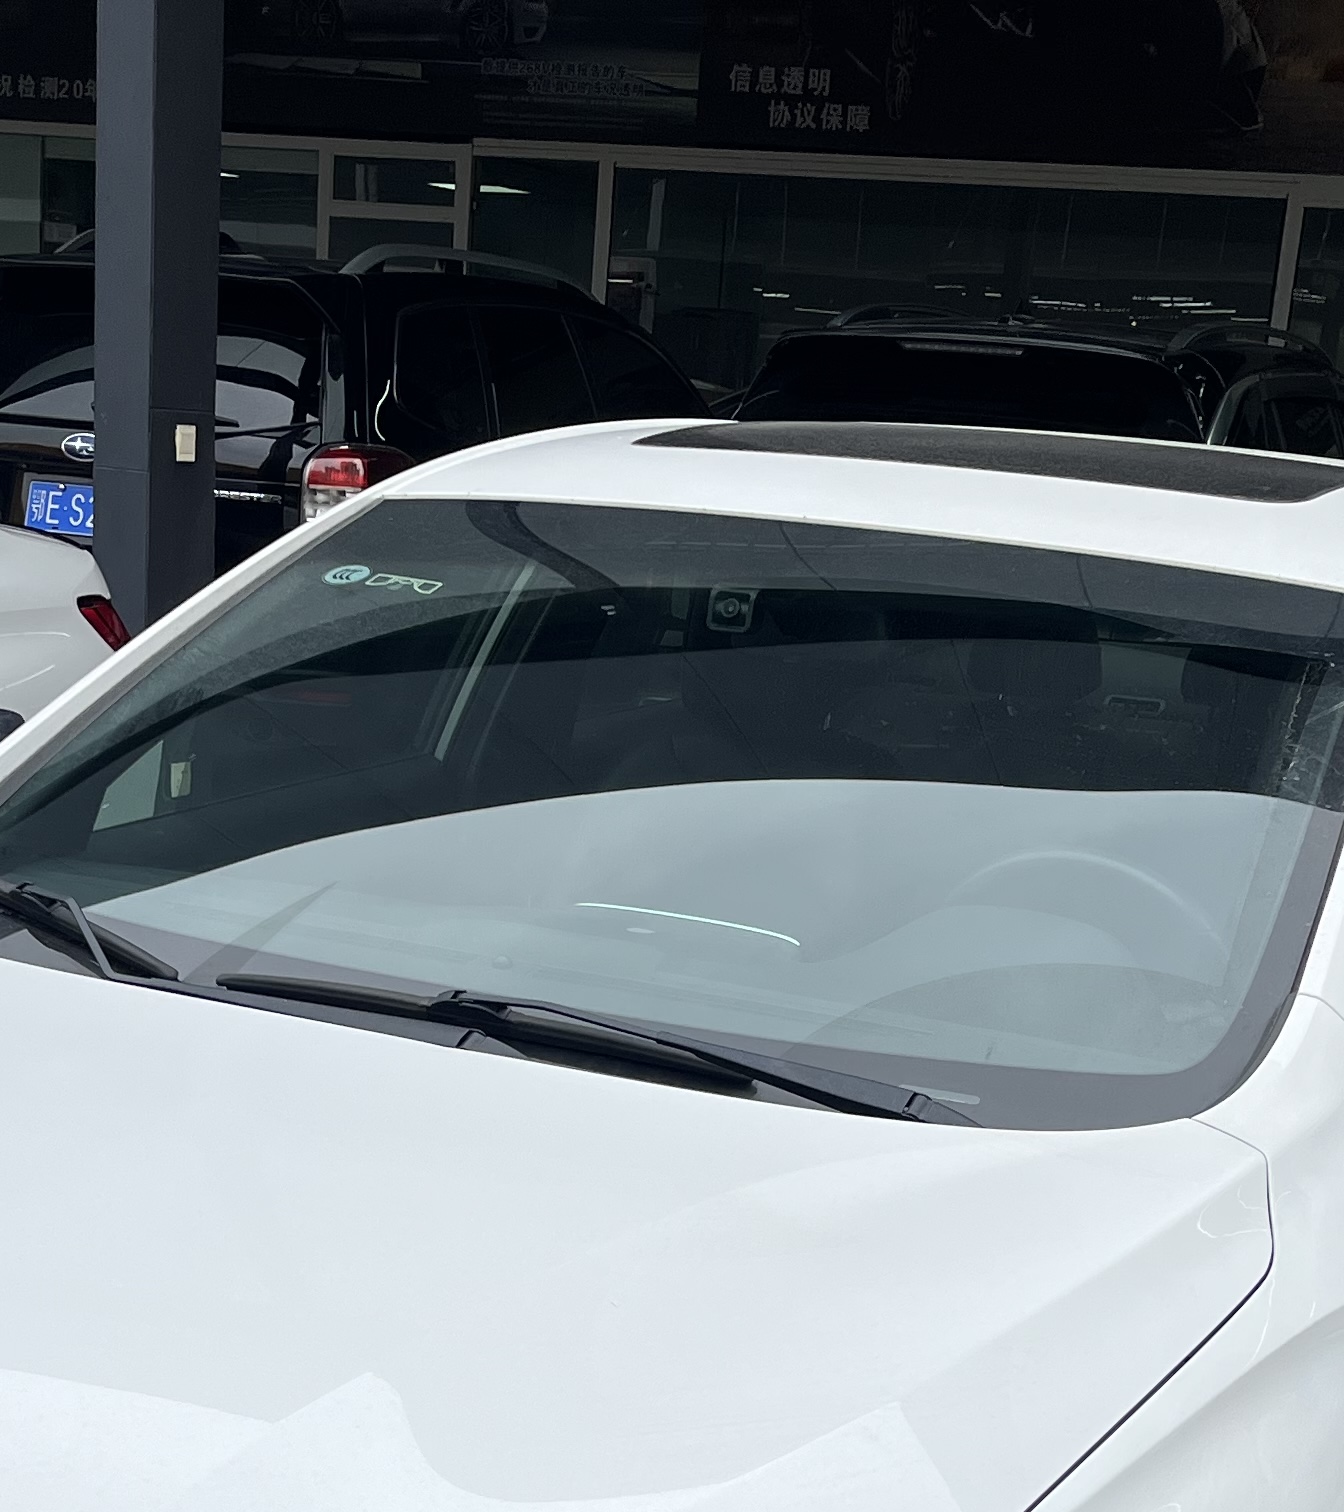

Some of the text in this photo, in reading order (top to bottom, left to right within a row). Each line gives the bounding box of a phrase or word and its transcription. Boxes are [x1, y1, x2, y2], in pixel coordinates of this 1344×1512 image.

[729, 63, 831, 97] 信息透明
[767, 99, 871, 132] 协议保障
